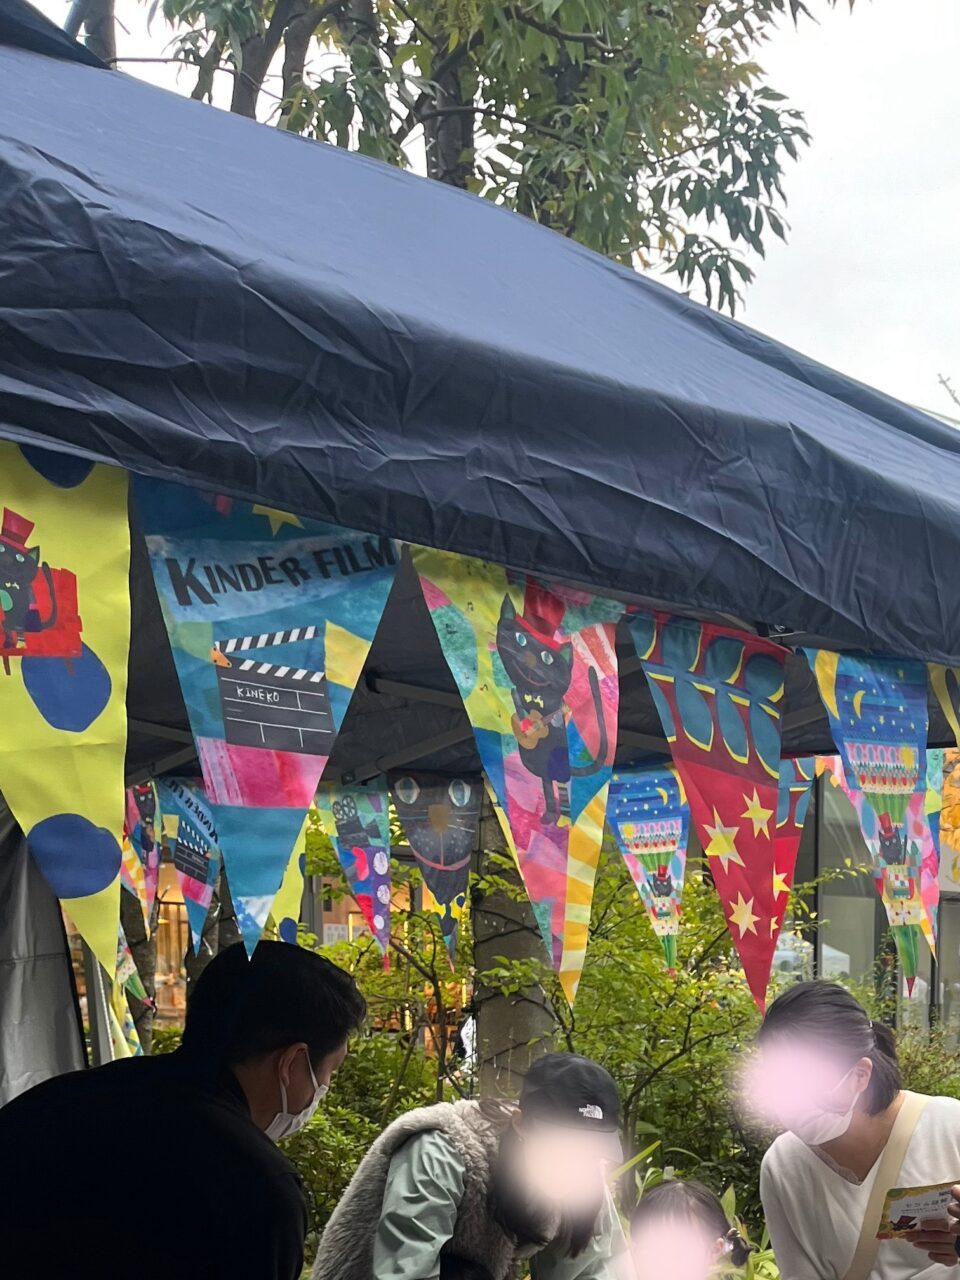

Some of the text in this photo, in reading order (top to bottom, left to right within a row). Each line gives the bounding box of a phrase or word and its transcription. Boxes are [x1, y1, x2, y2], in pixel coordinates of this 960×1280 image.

[165, 537, 397, 607] KINDER FILM
[236, 685, 280, 703] KINEKO
